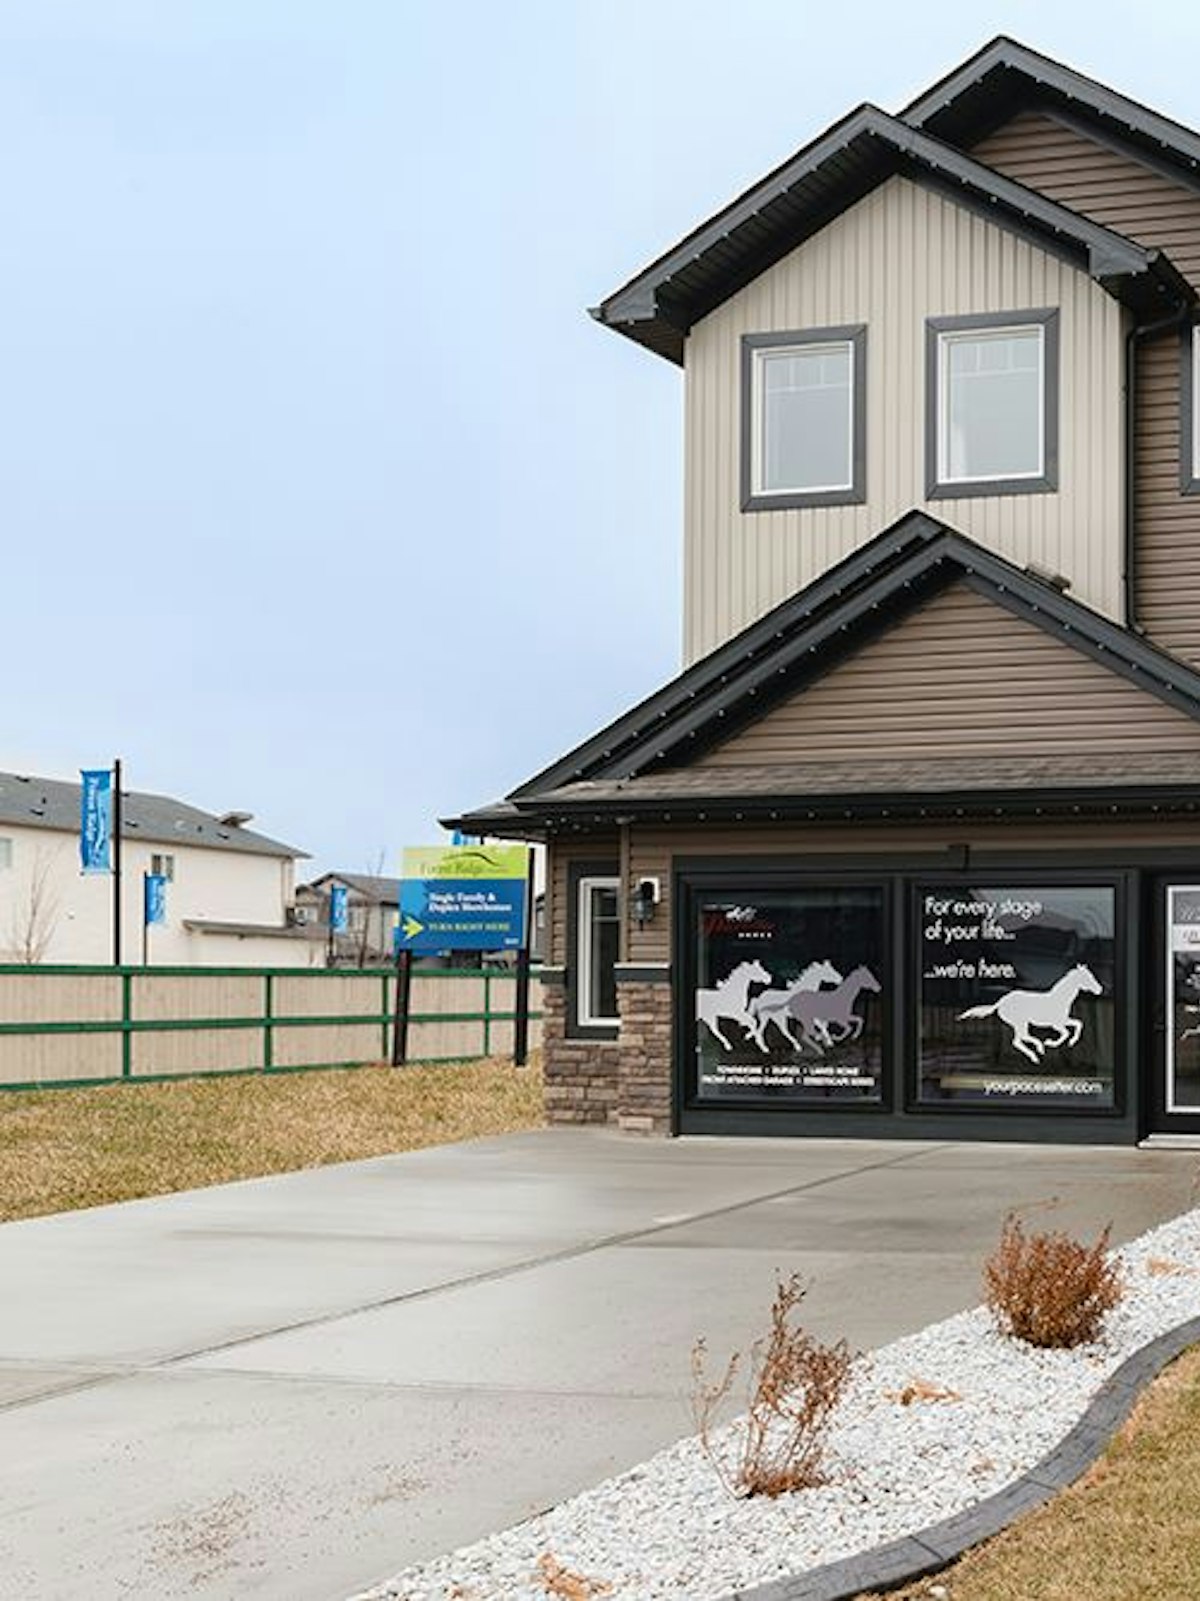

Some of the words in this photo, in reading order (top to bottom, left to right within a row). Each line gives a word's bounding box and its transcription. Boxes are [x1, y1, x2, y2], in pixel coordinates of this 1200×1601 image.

[925, 897, 951, 915] For
[953, 901, 996, 919] every
[1000, 900, 1042, 920] stage
[925, 919, 942, 940] of
[944, 925, 979, 944] your
[978, 958, 1016, 978] here.
